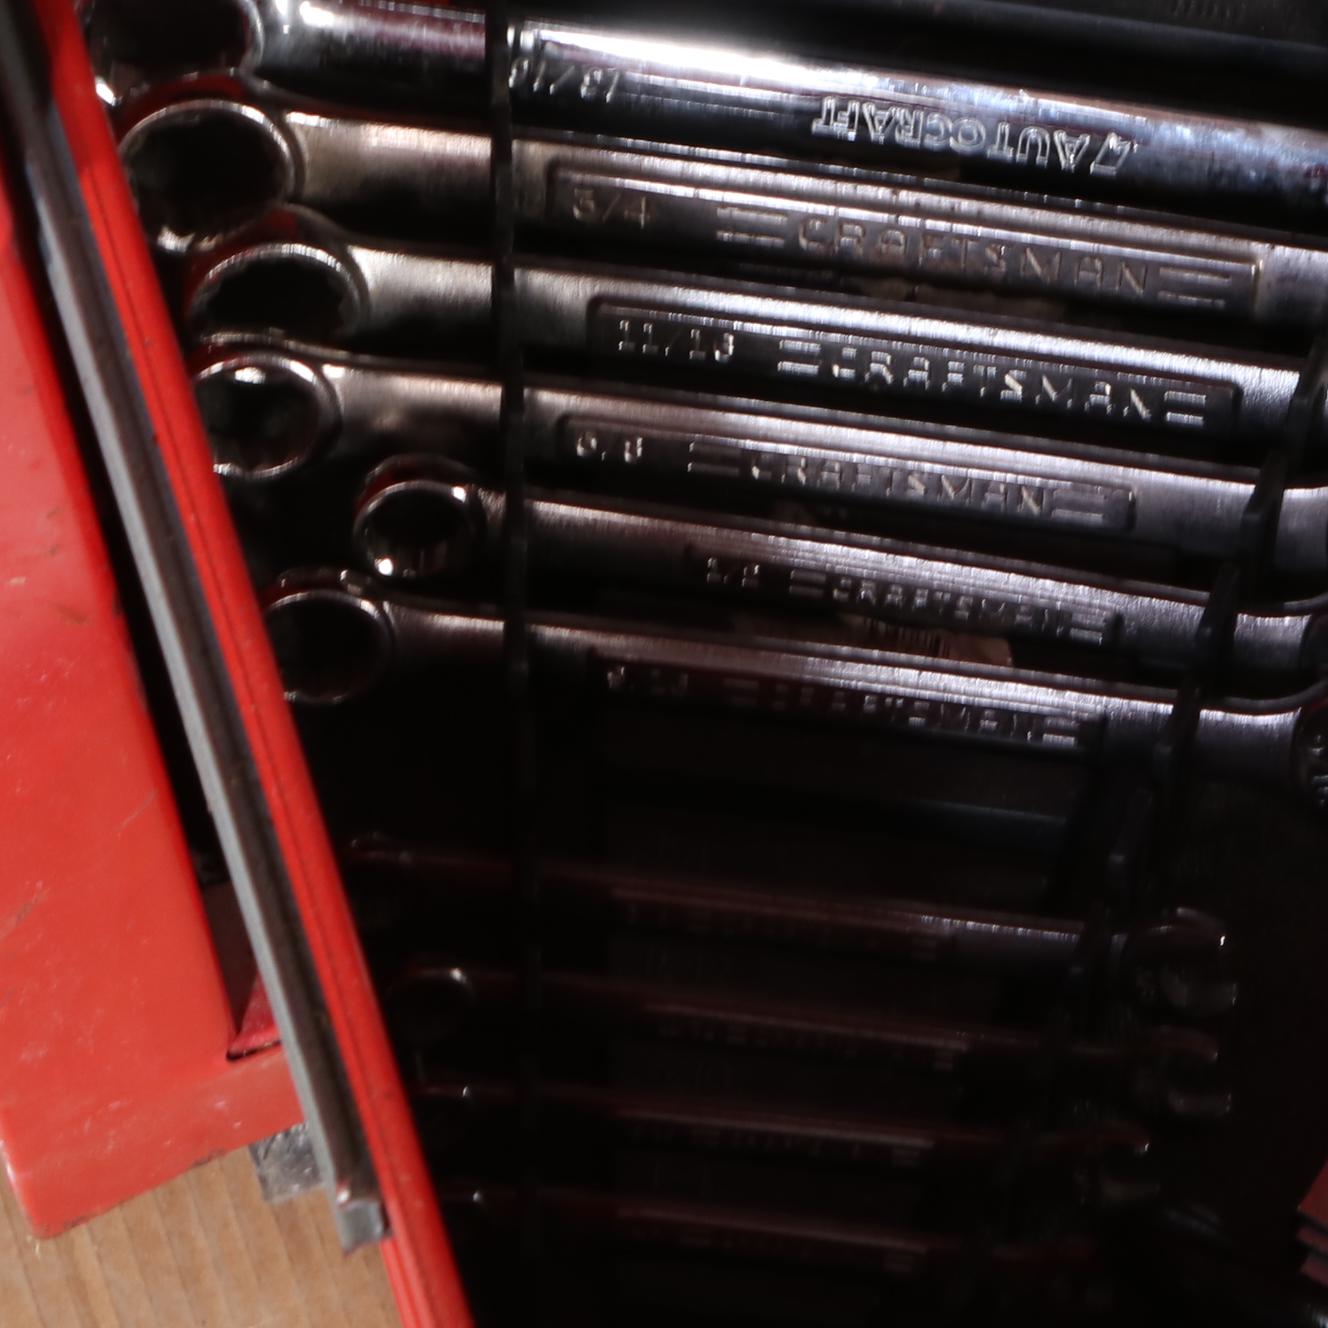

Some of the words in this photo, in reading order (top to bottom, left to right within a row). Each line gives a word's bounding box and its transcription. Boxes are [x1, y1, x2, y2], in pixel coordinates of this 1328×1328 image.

[811, 97, 1090, 178] AUTOCRAFT
[570, 187, 650, 229] 3/4
[797, 213, 1148, 295] CRAFTSMAN
[831, 345, 1151, 421] CRAFTSMAN
[751, 456, 1042, 517] CRAFTSMAN
[833, 576, 1064, 637] CRAFTSMAN
